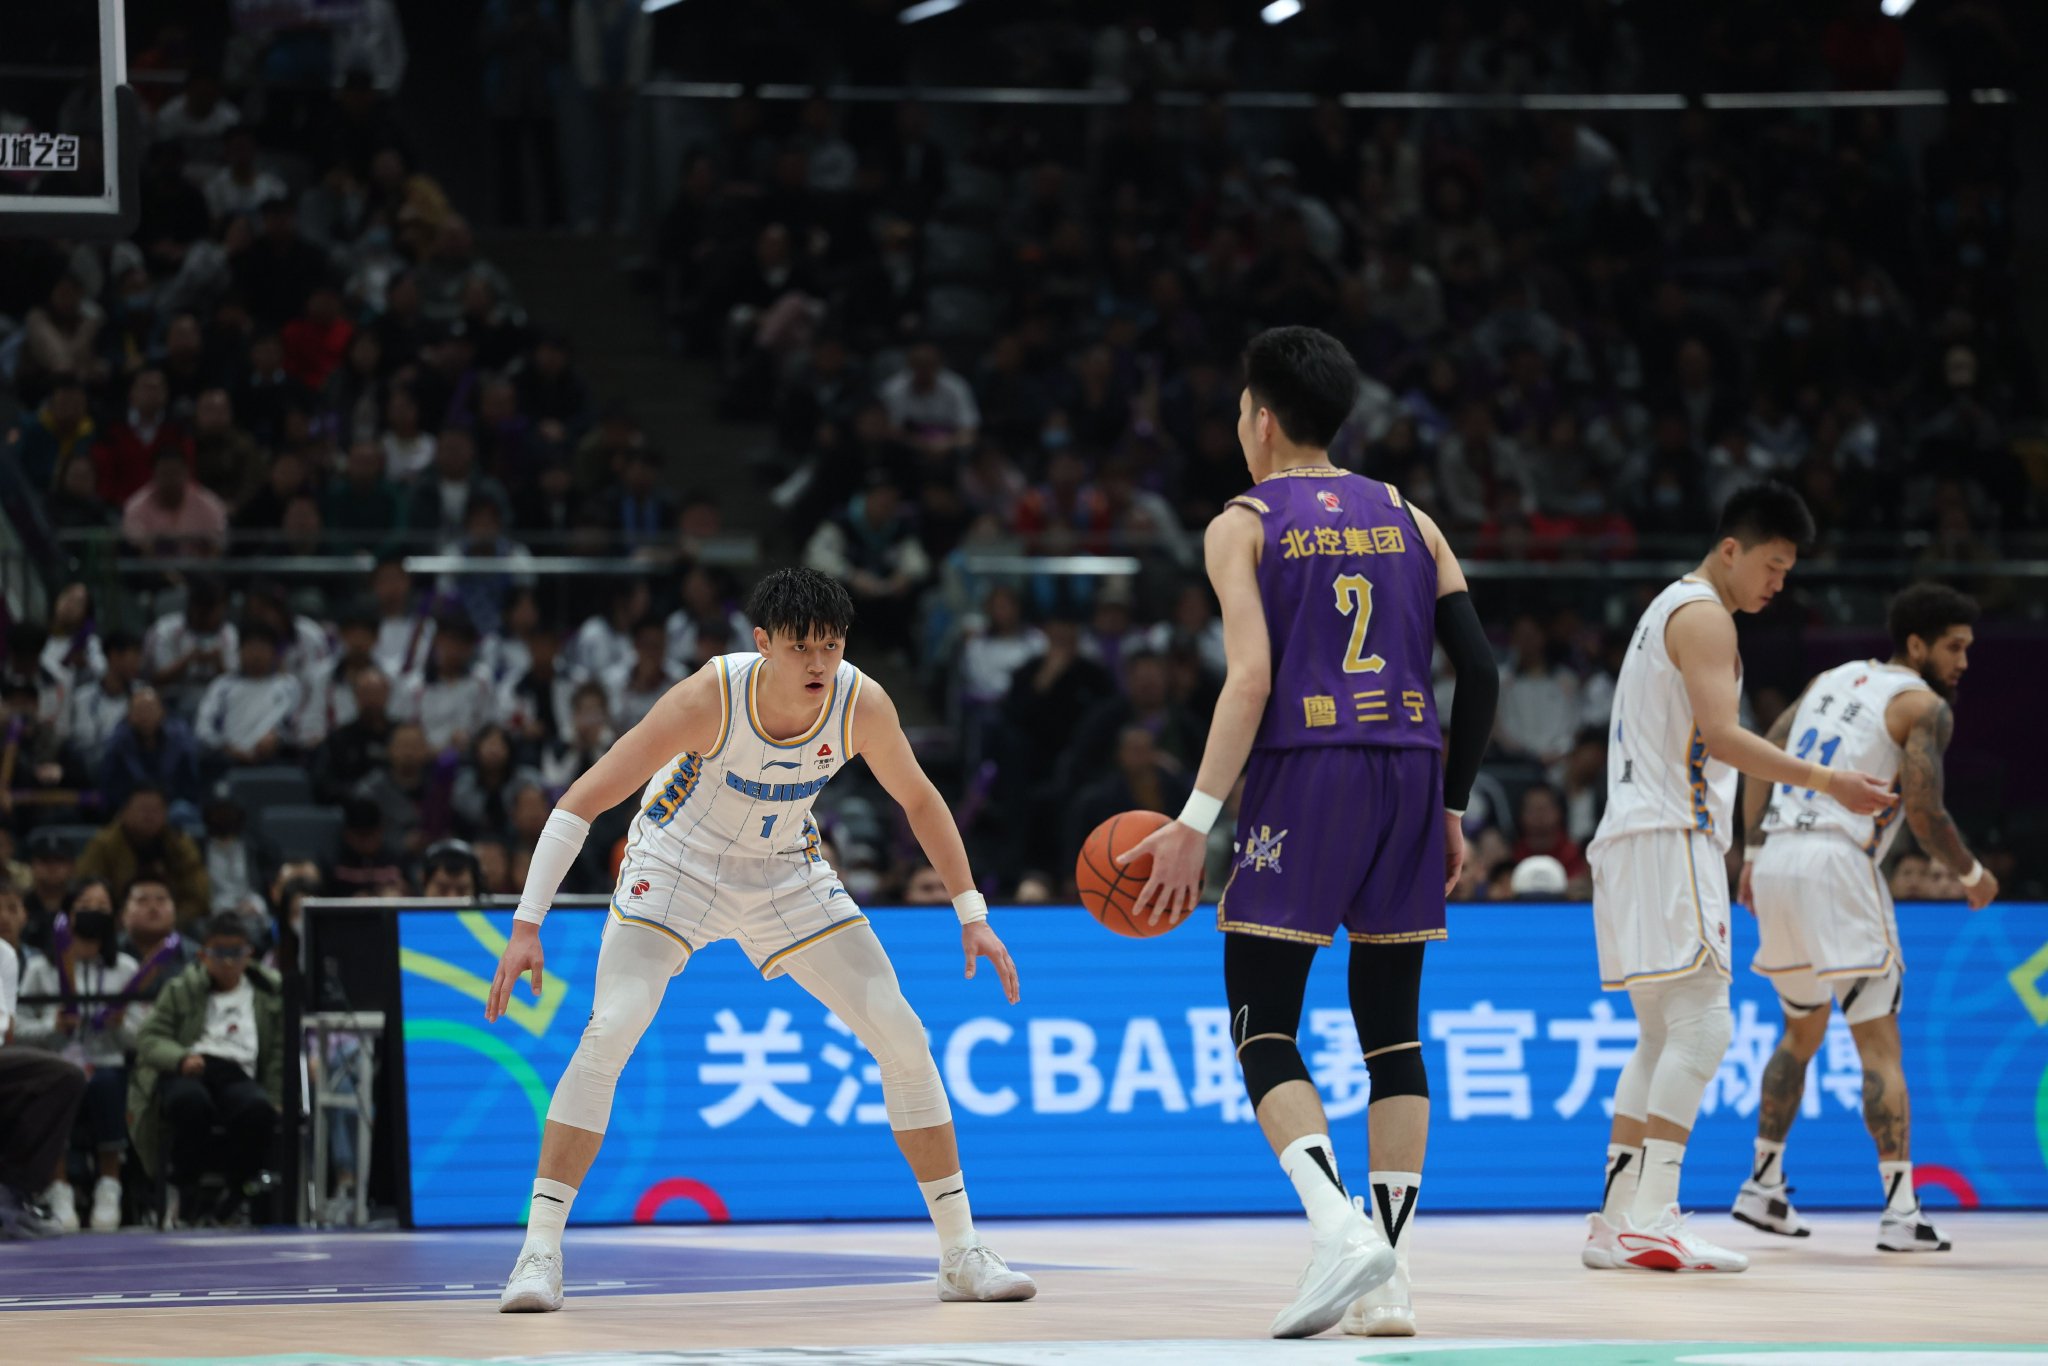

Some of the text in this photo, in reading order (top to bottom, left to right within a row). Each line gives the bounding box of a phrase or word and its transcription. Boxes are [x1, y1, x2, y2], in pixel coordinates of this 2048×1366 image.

[1280, 526, 1406, 559] 北控集团
[1332, 572, 1387, 674] 2
[760, 813, 778, 839] 1
